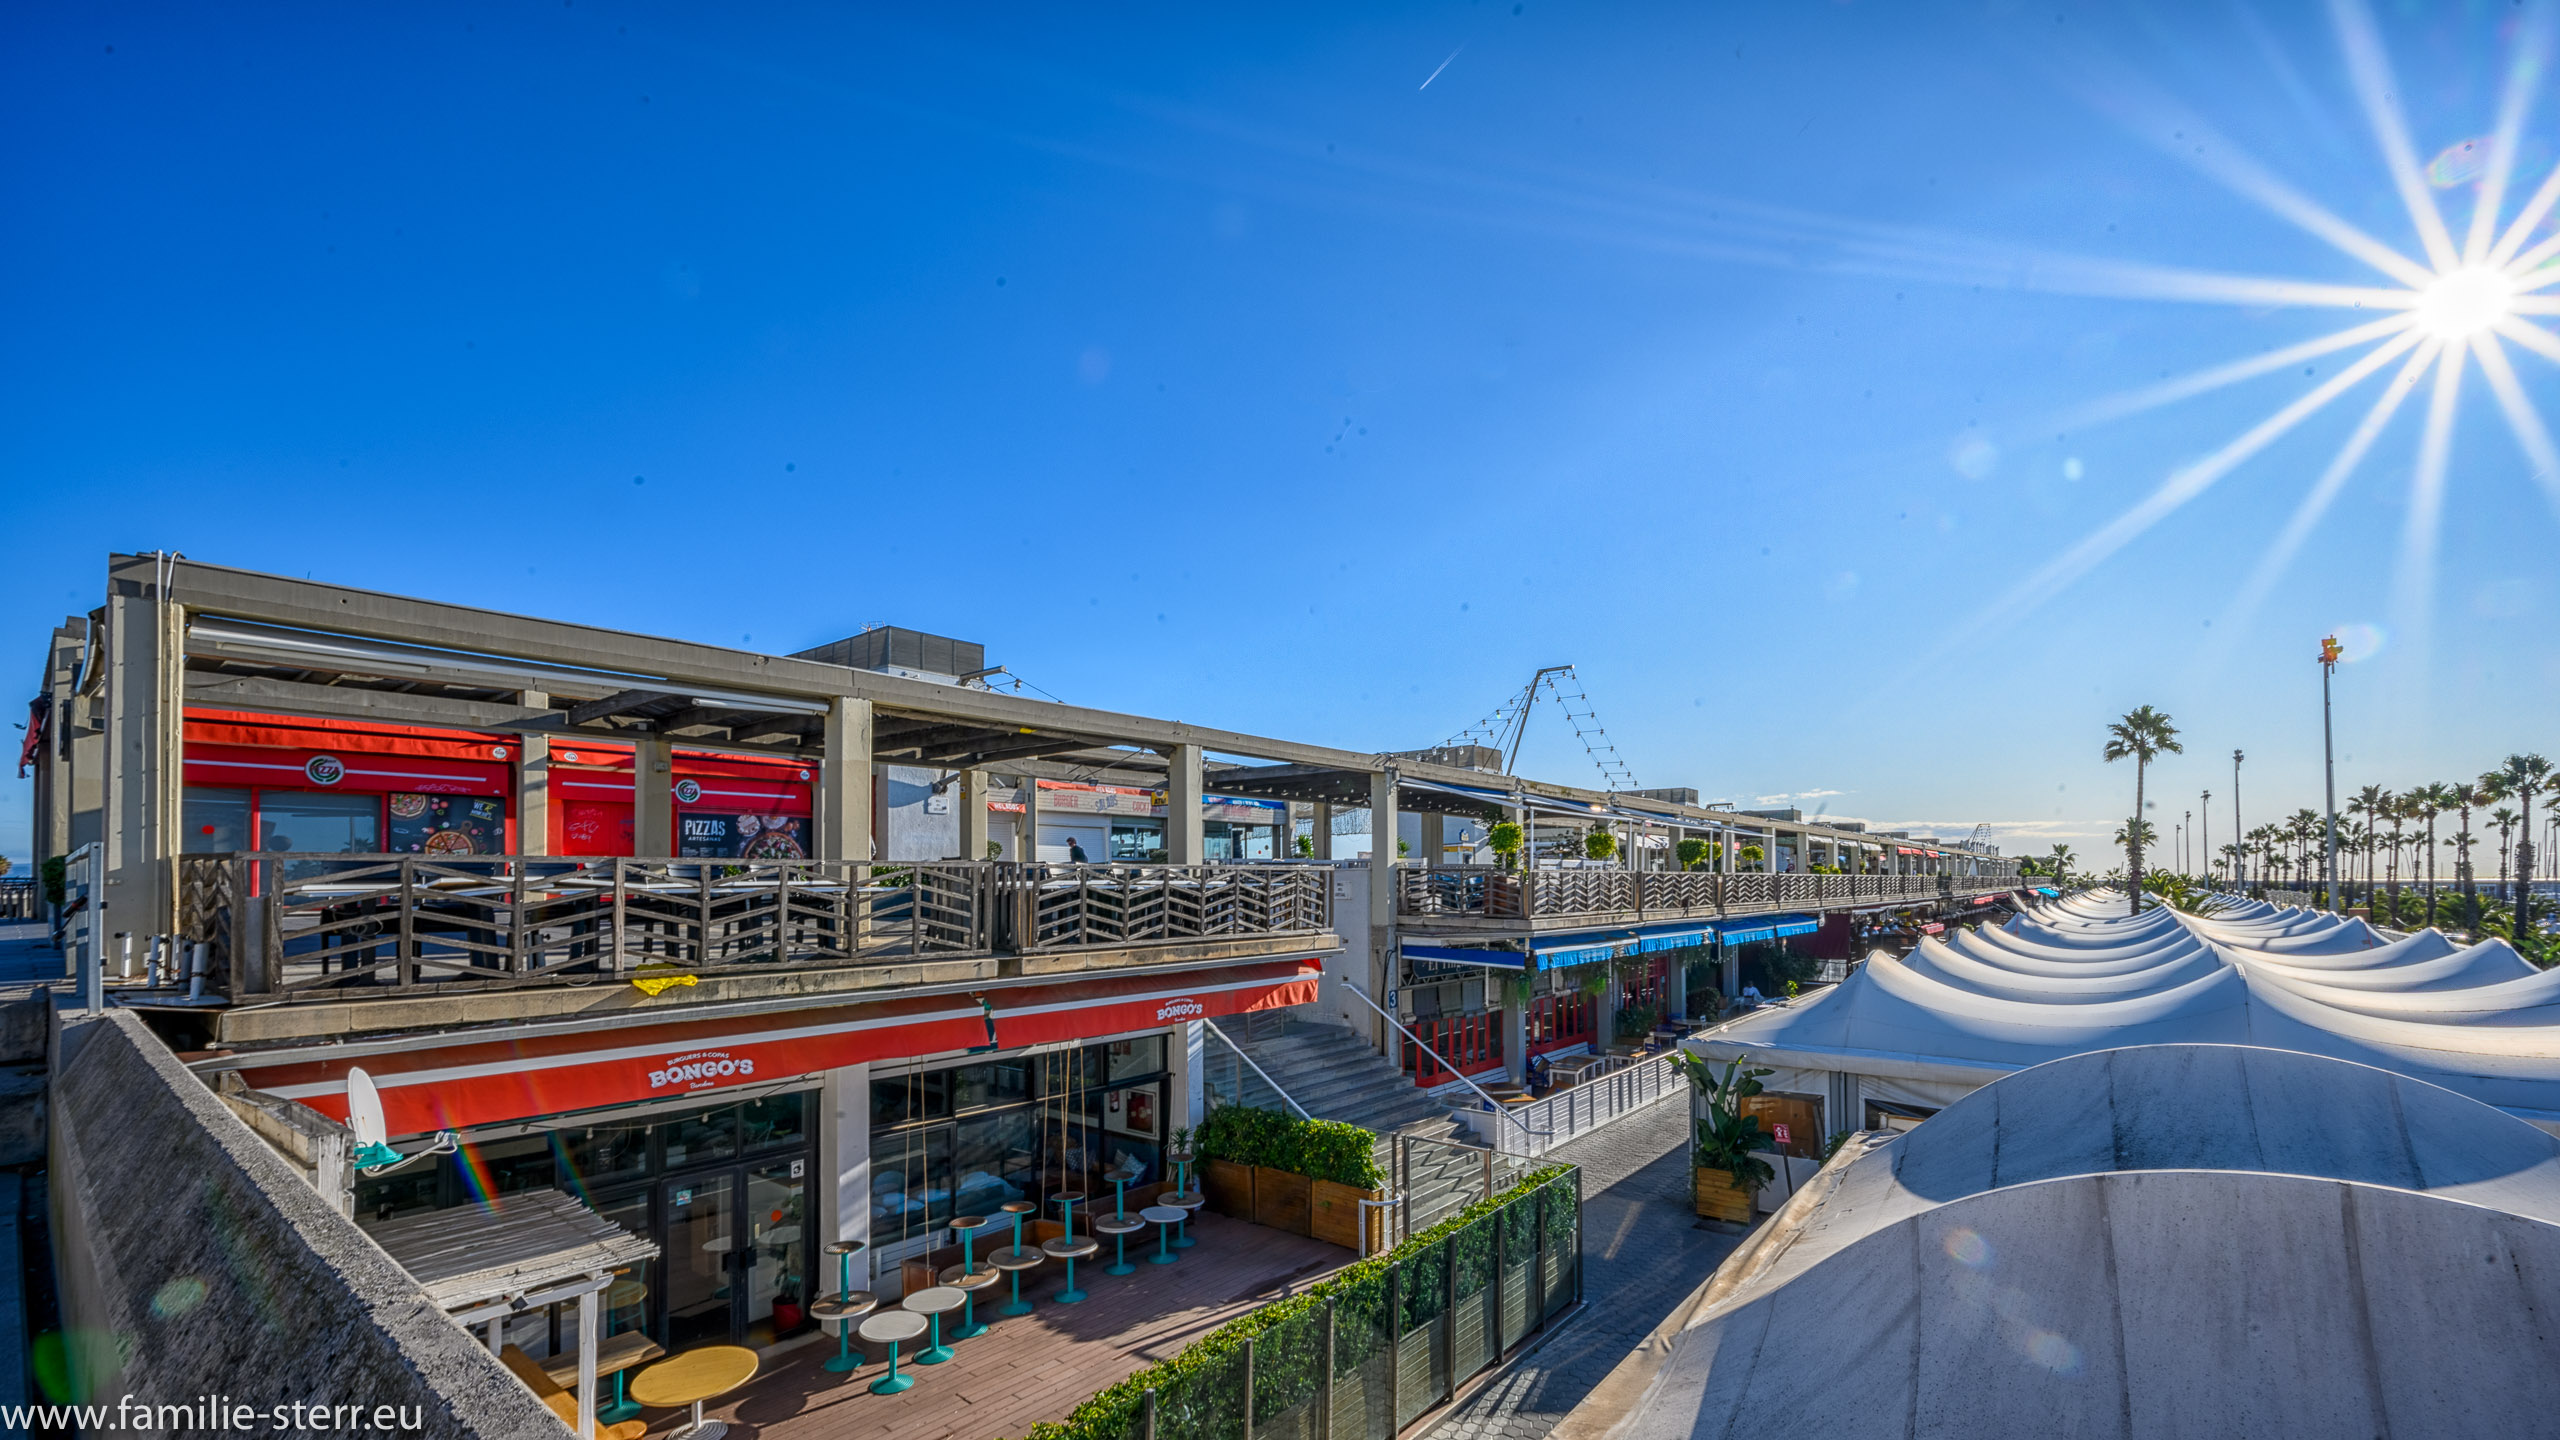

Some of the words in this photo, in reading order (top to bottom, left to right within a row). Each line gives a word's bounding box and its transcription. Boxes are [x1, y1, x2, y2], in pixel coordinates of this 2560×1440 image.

[994, 802, 1020, 811] HELADOS
[1053, 792, 1079, 808] BURGER
[1095, 795, 1118, 813] SALADS
[1154, 797, 1167, 805] ATM
[685, 819, 726, 836] PIZZAS
[1389, 991, 1397, 1007] 3
[1156, 1003, 1203, 1021] BONGO'S
[666, 1052, 701, 1066] BURGUERS
[648, 1059, 754, 1088] BONGO'S
